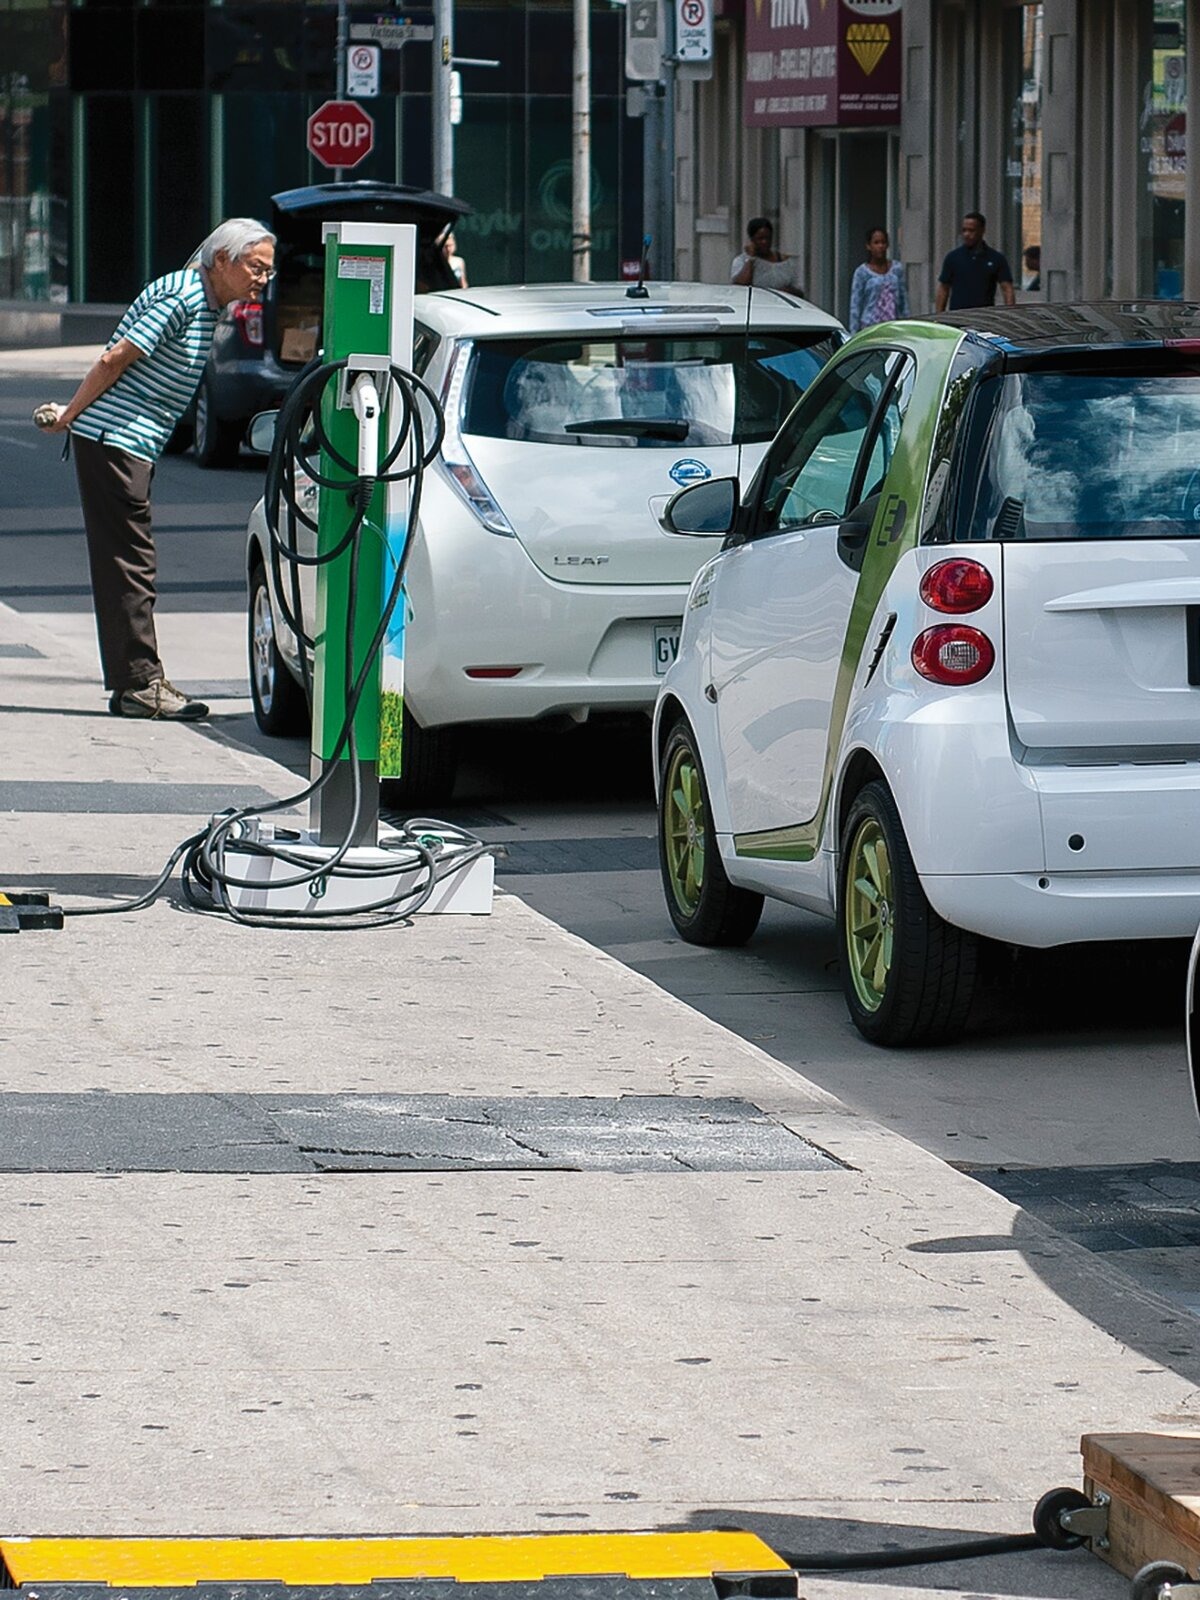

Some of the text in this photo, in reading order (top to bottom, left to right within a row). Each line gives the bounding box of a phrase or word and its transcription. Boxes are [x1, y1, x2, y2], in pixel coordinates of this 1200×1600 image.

[312, 121, 369, 148] STOP
[553, 556, 610, 566] LEAF
[657, 636, 681, 663] GV
